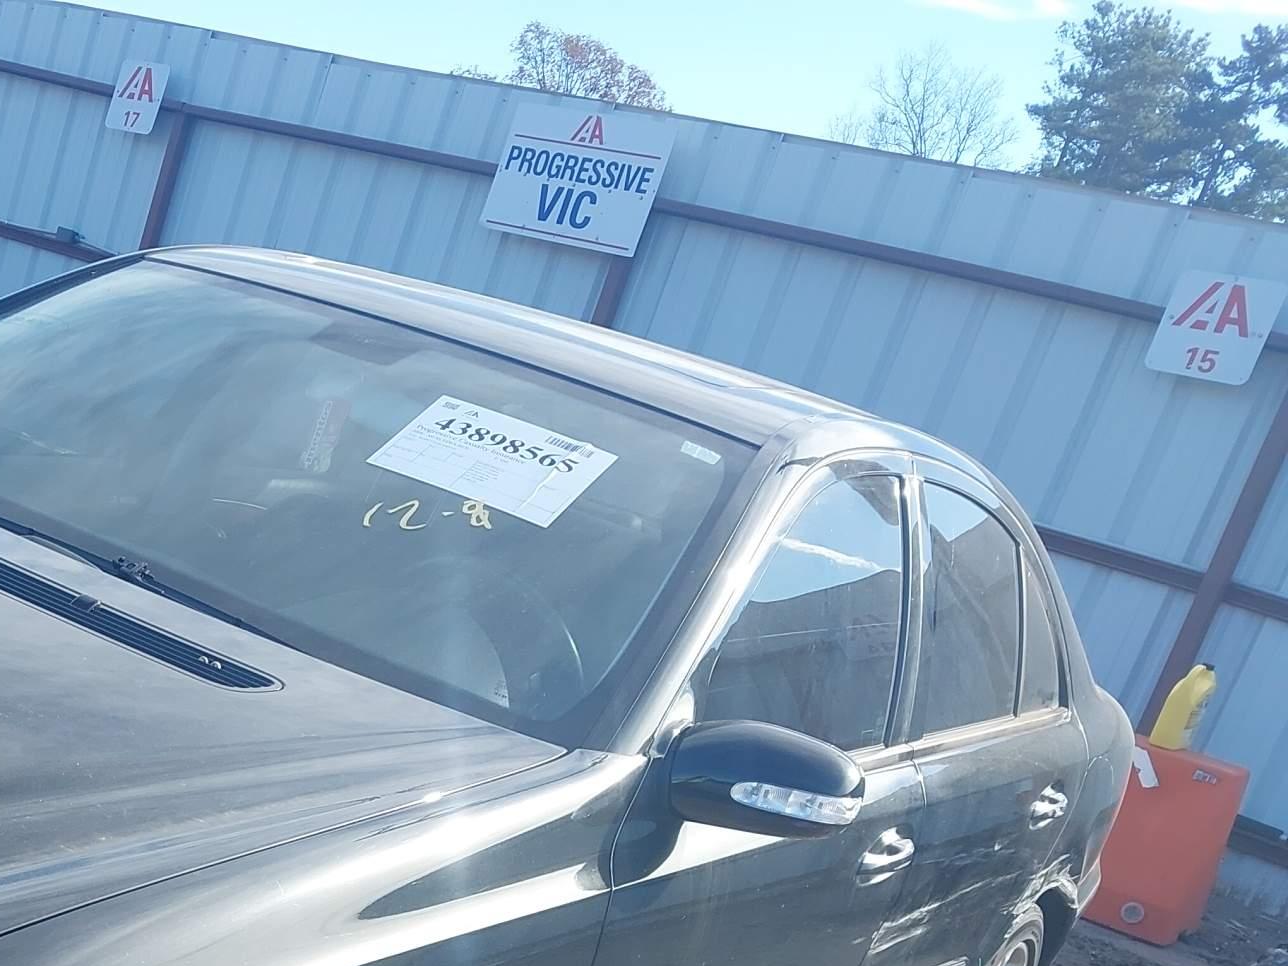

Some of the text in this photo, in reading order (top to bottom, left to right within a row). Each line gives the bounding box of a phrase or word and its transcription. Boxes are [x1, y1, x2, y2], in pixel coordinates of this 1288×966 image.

[123, 110, 141, 128] 17
[504, 145, 655, 194] PROGRESSIVE
[537, 183, 598, 230] VIC
[1185, 347, 1220, 373] 15
[434, 417, 580, 473] 43898565
